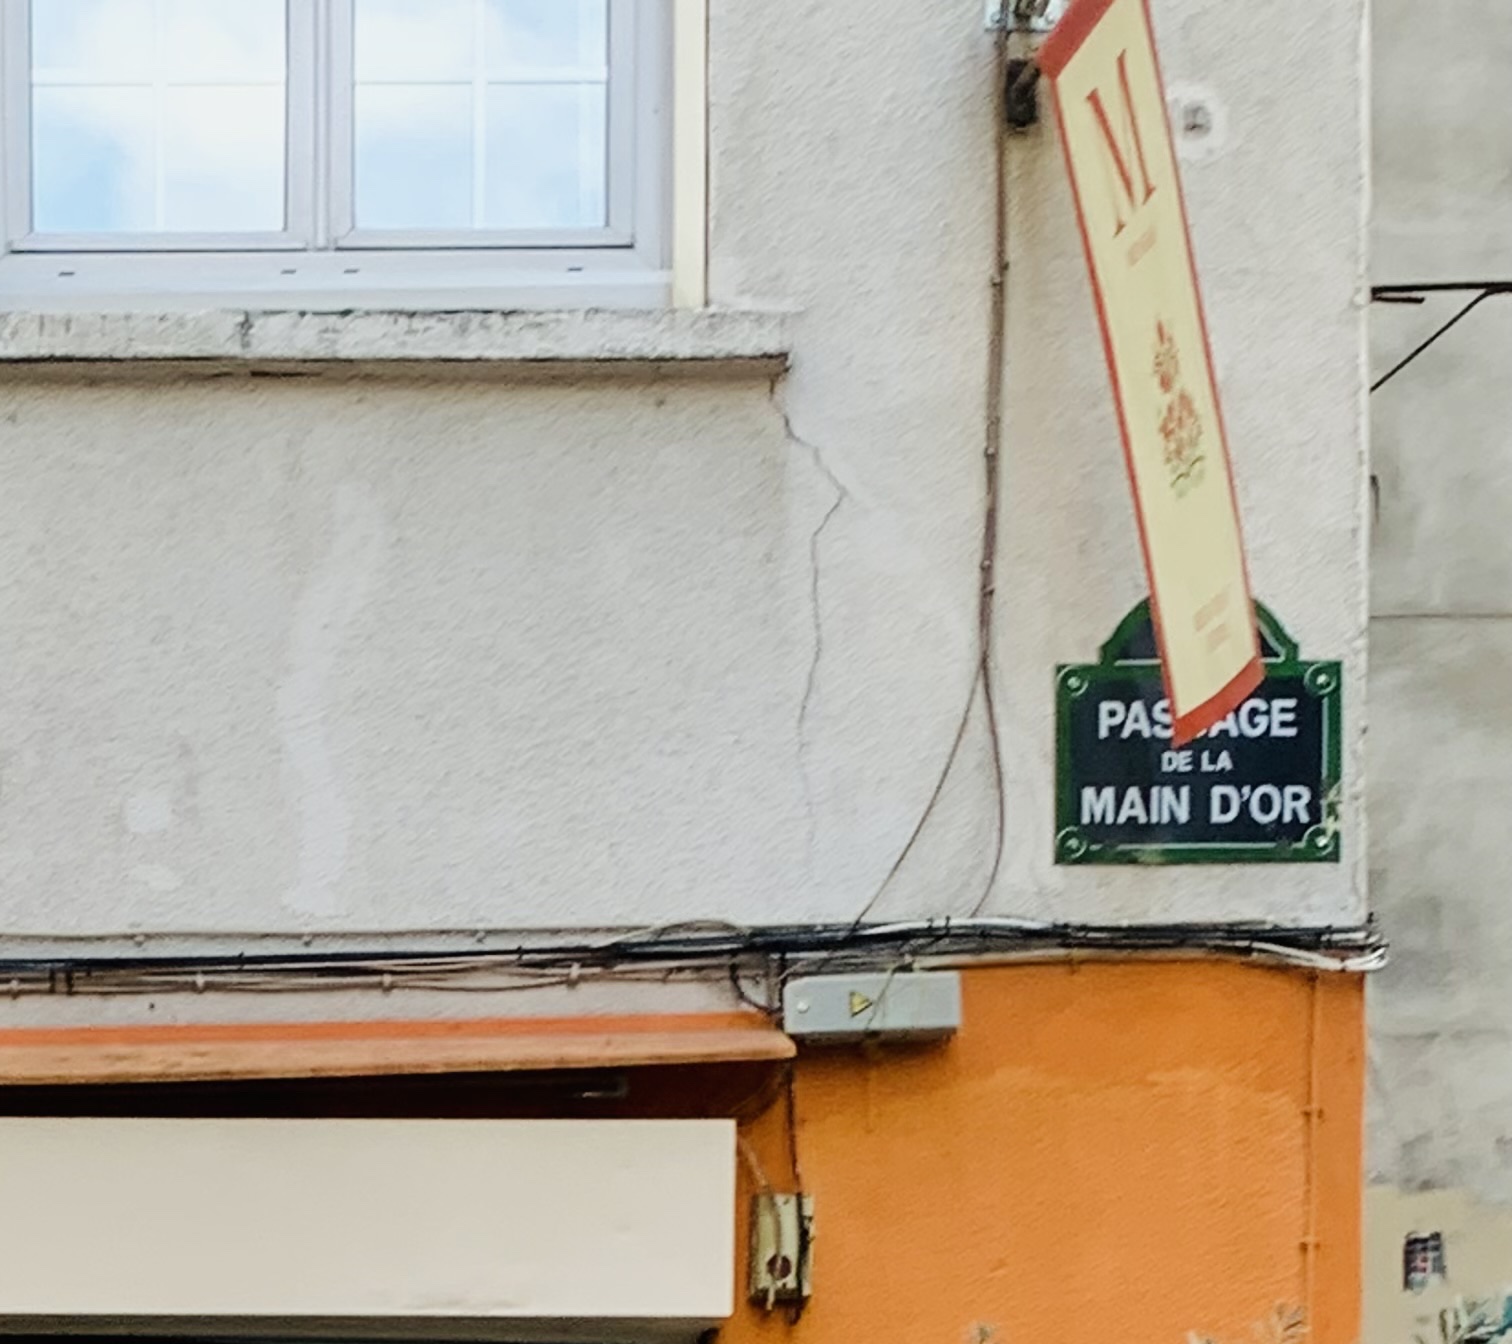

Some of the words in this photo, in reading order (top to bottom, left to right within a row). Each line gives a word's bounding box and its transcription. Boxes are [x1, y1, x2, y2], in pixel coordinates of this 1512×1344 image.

[1097, 697, 1299, 739] PASAGE
[1160, 750, 1194, 773] DE
[1199, 750, 1234, 773] LA
[1080, 785, 1191, 825] MAIN
[1208, 783, 1312, 825] D'OR
